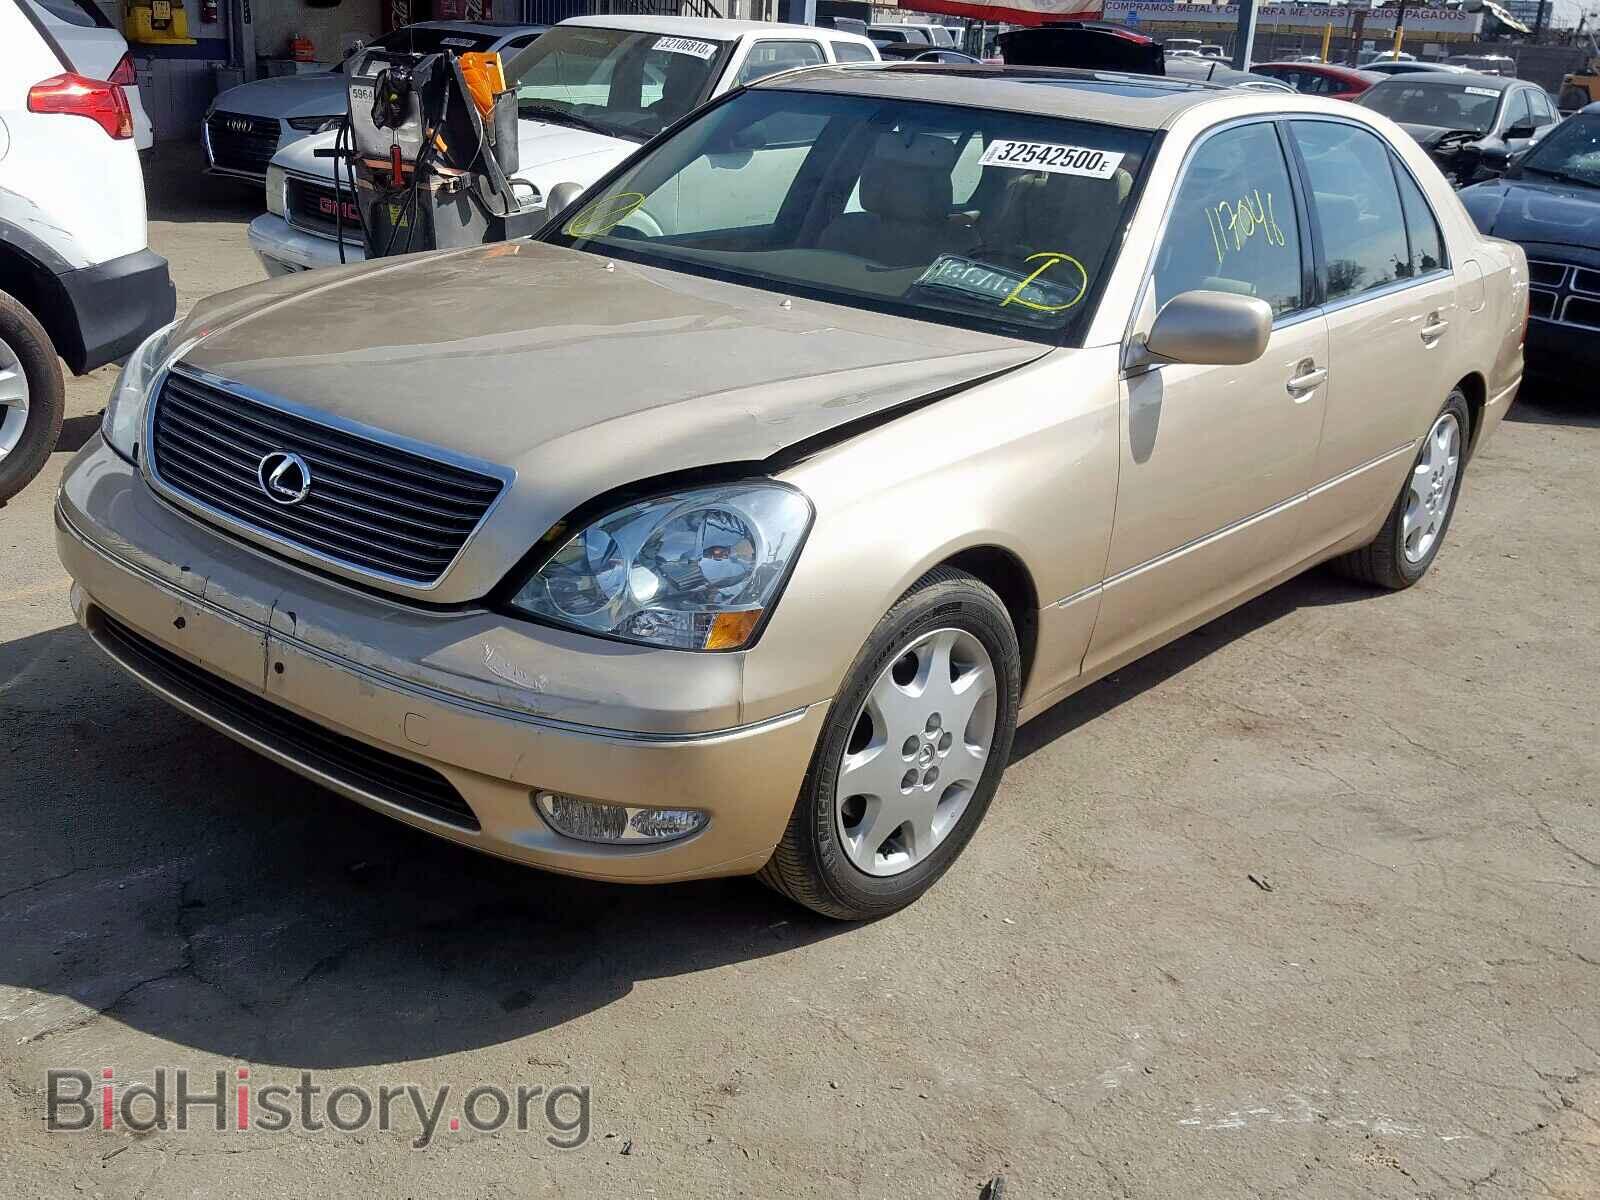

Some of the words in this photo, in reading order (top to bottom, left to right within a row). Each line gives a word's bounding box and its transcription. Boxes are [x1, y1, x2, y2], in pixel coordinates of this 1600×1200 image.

[1105, 2, 1174, 12] COMPRAMOS
[1178, 4, 1212, 13] METAL
[1215, 5, 1221, 13] Y
[1226, 5, 1286, 16] CHARRA
[1349, 8, 1399, 18] PECIOS
[1404, 9, 1466, 20] PAGADOS
[320, 197, 361, 221] GMC
